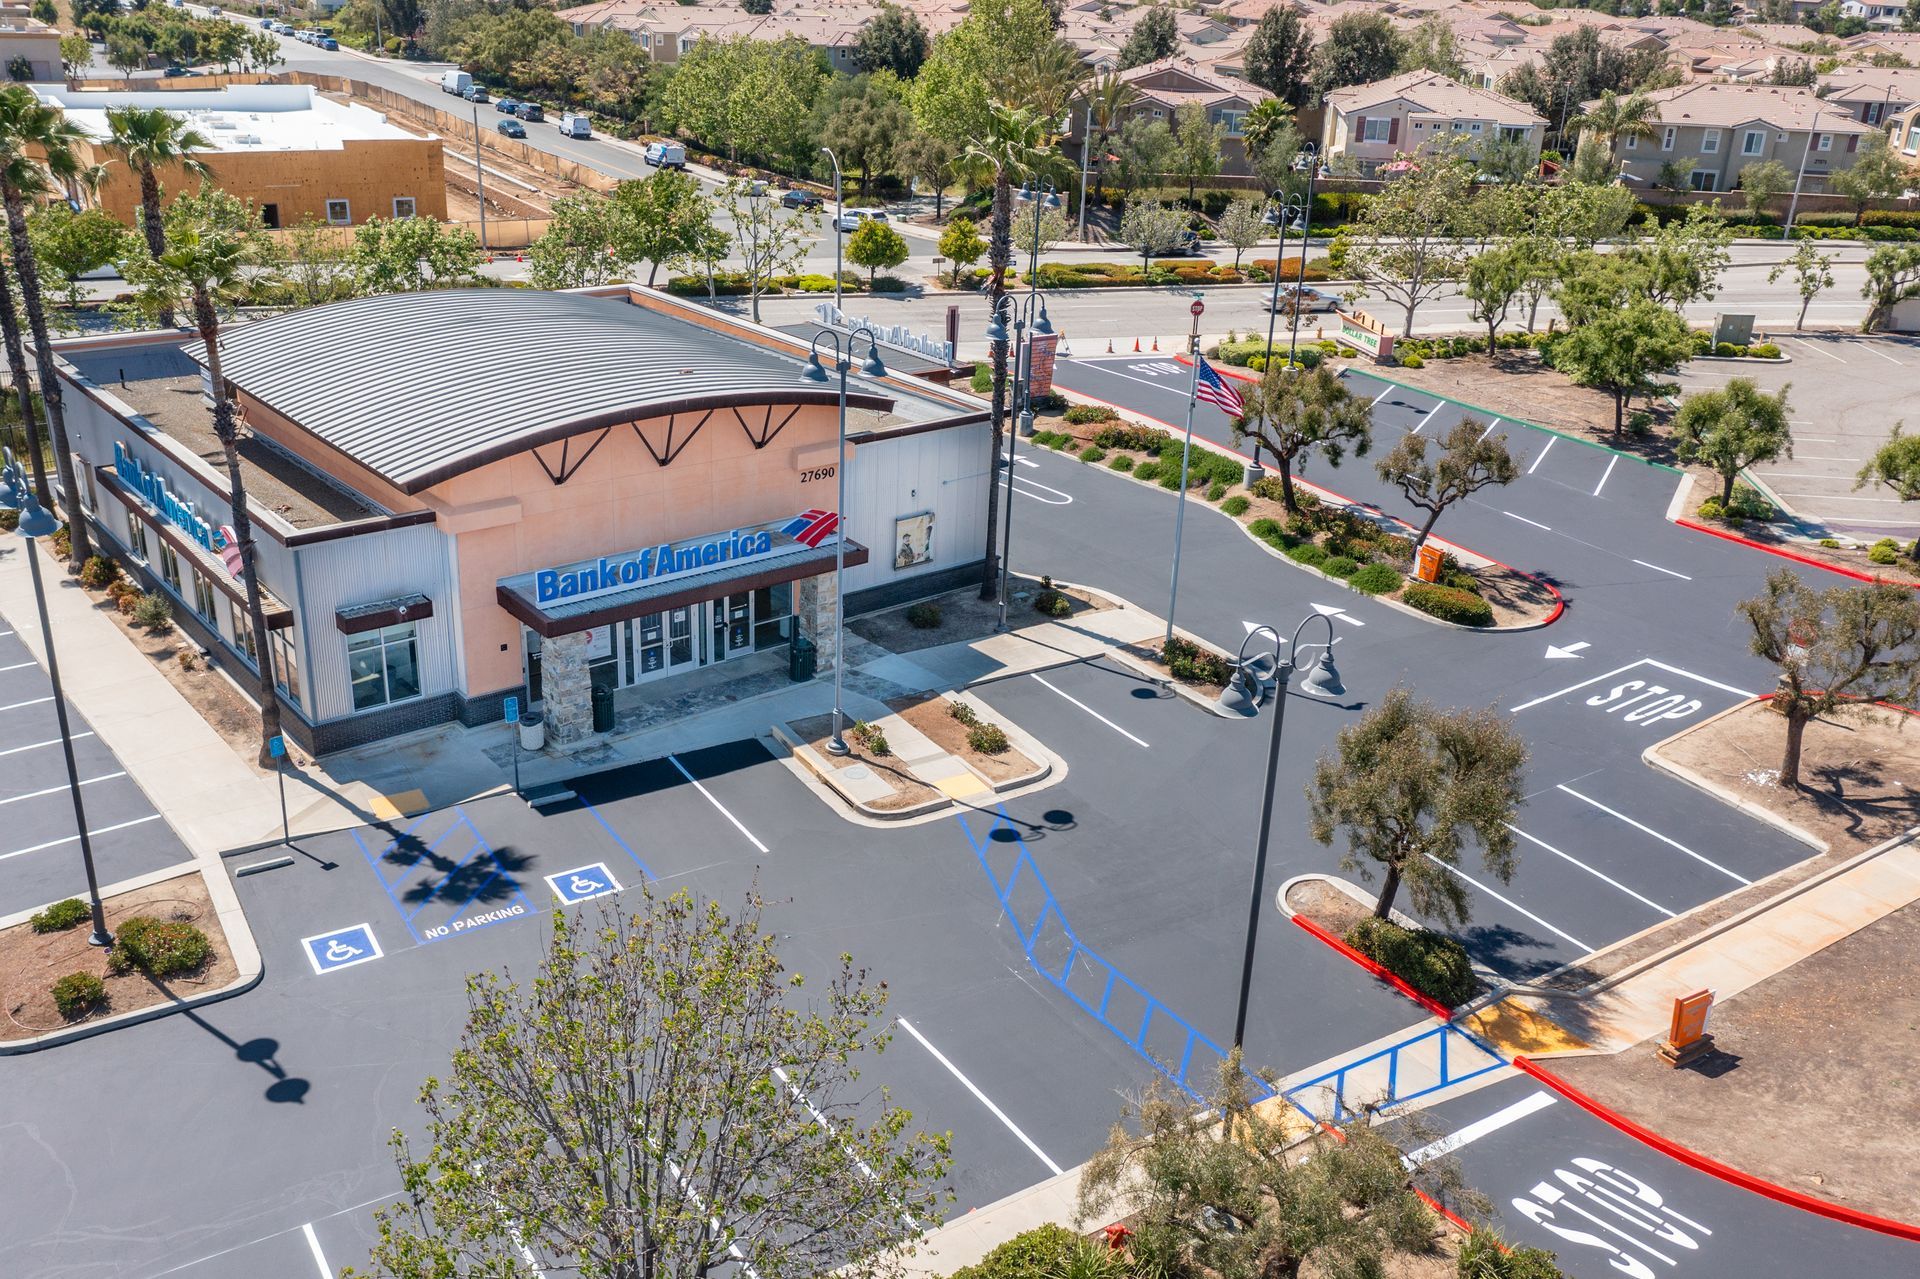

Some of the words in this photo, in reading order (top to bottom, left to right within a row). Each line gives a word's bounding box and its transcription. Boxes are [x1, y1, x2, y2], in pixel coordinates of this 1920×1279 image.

[1342, 325, 1363, 341] DOLLAR
[1364, 335, 1378, 347] TREE
[1127, 362, 1187, 376] STOP
[800, 467, 835, 483] 27690
[535, 557, 619, 602] Bank
[620, 547, 653, 584] of
[653, 529, 771, 577] America
[1585, 680, 1703, 727] STOP
[424, 925, 450, 940] NO
[452, 905, 525, 932] PARKING
[1511, 1157, 1713, 1279] STOP
